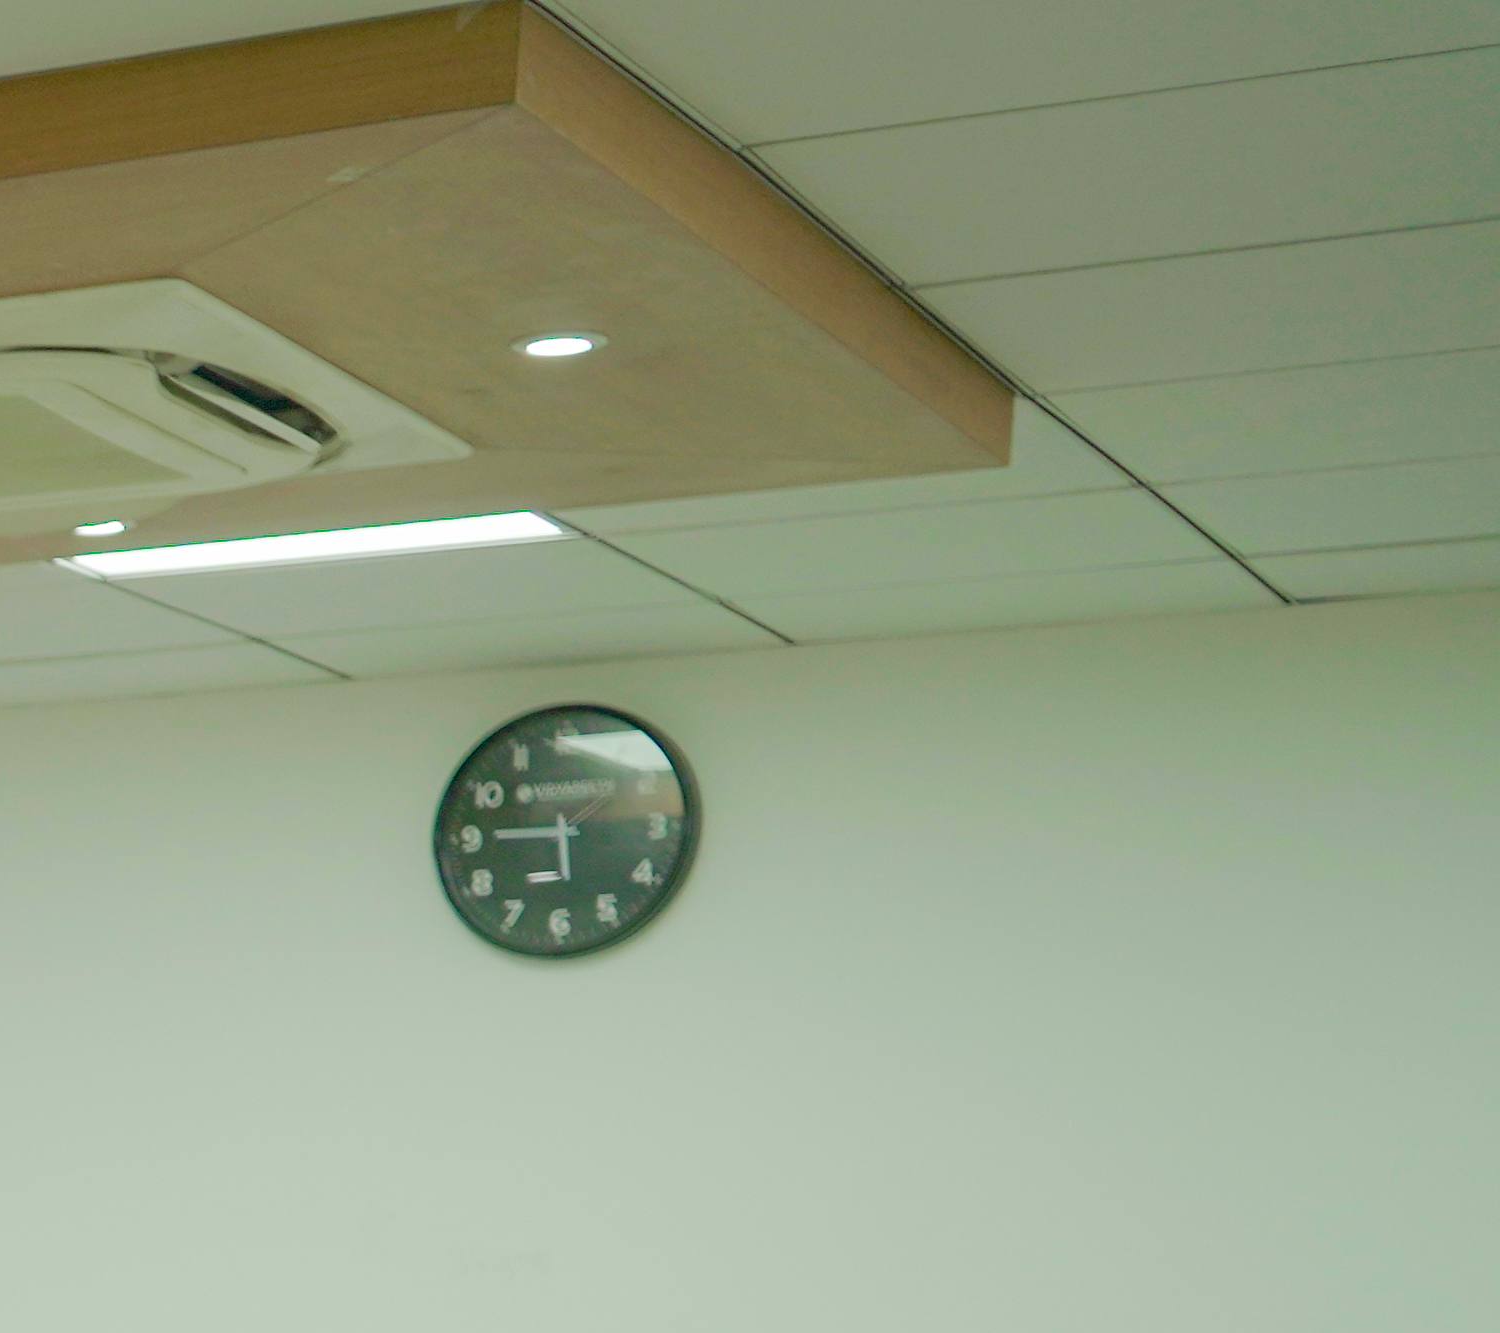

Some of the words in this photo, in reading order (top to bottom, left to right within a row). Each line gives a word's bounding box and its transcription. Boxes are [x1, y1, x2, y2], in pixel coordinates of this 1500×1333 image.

[475, 780, 504, 809] 10
[461, 825, 483, 853] 9
[648, 813, 667, 840] 3
[471, 869, 493, 896] 8
[632, 858, 652, 885] 4
[504, 899, 525, 928] 7
[597, 893, 617, 922] 5
[549, 907, 571, 937] 6
